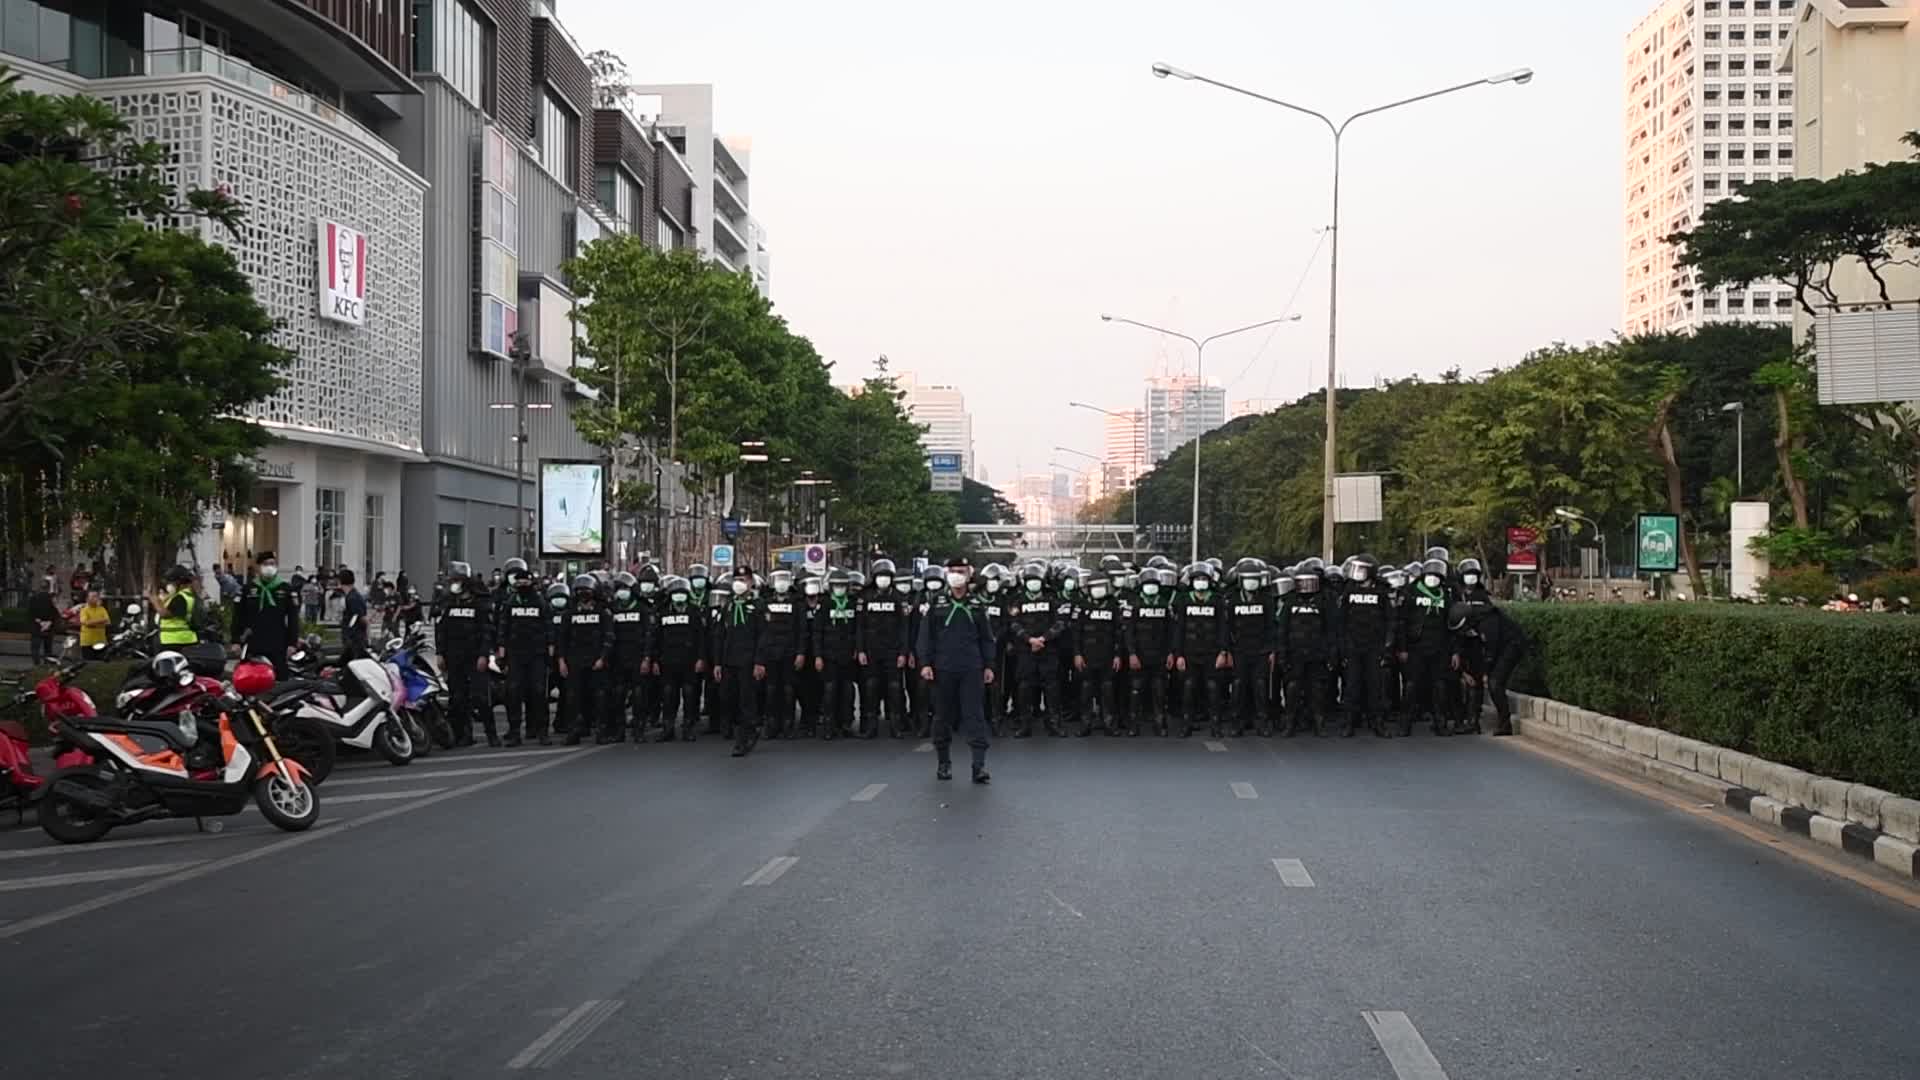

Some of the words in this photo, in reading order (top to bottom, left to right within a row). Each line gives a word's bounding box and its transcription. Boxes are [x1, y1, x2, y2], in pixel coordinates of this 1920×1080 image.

[334, 296, 359, 320] KFC
[1349, 594, 1379, 604] POLICE
[867, 602, 895, 611] POLICE
[1021, 602, 1050, 612] POLICE
[1186, 606, 1215, 616] POLICE
[1234, 605, 1264, 615] POLICE
[448, 608, 475, 617] POLICE
[511, 608, 540, 617] POLICE
[613, 612, 640, 622] POLICE
[571, 614, 600, 624] POLICE
[661, 615, 689, 625] POLICE
